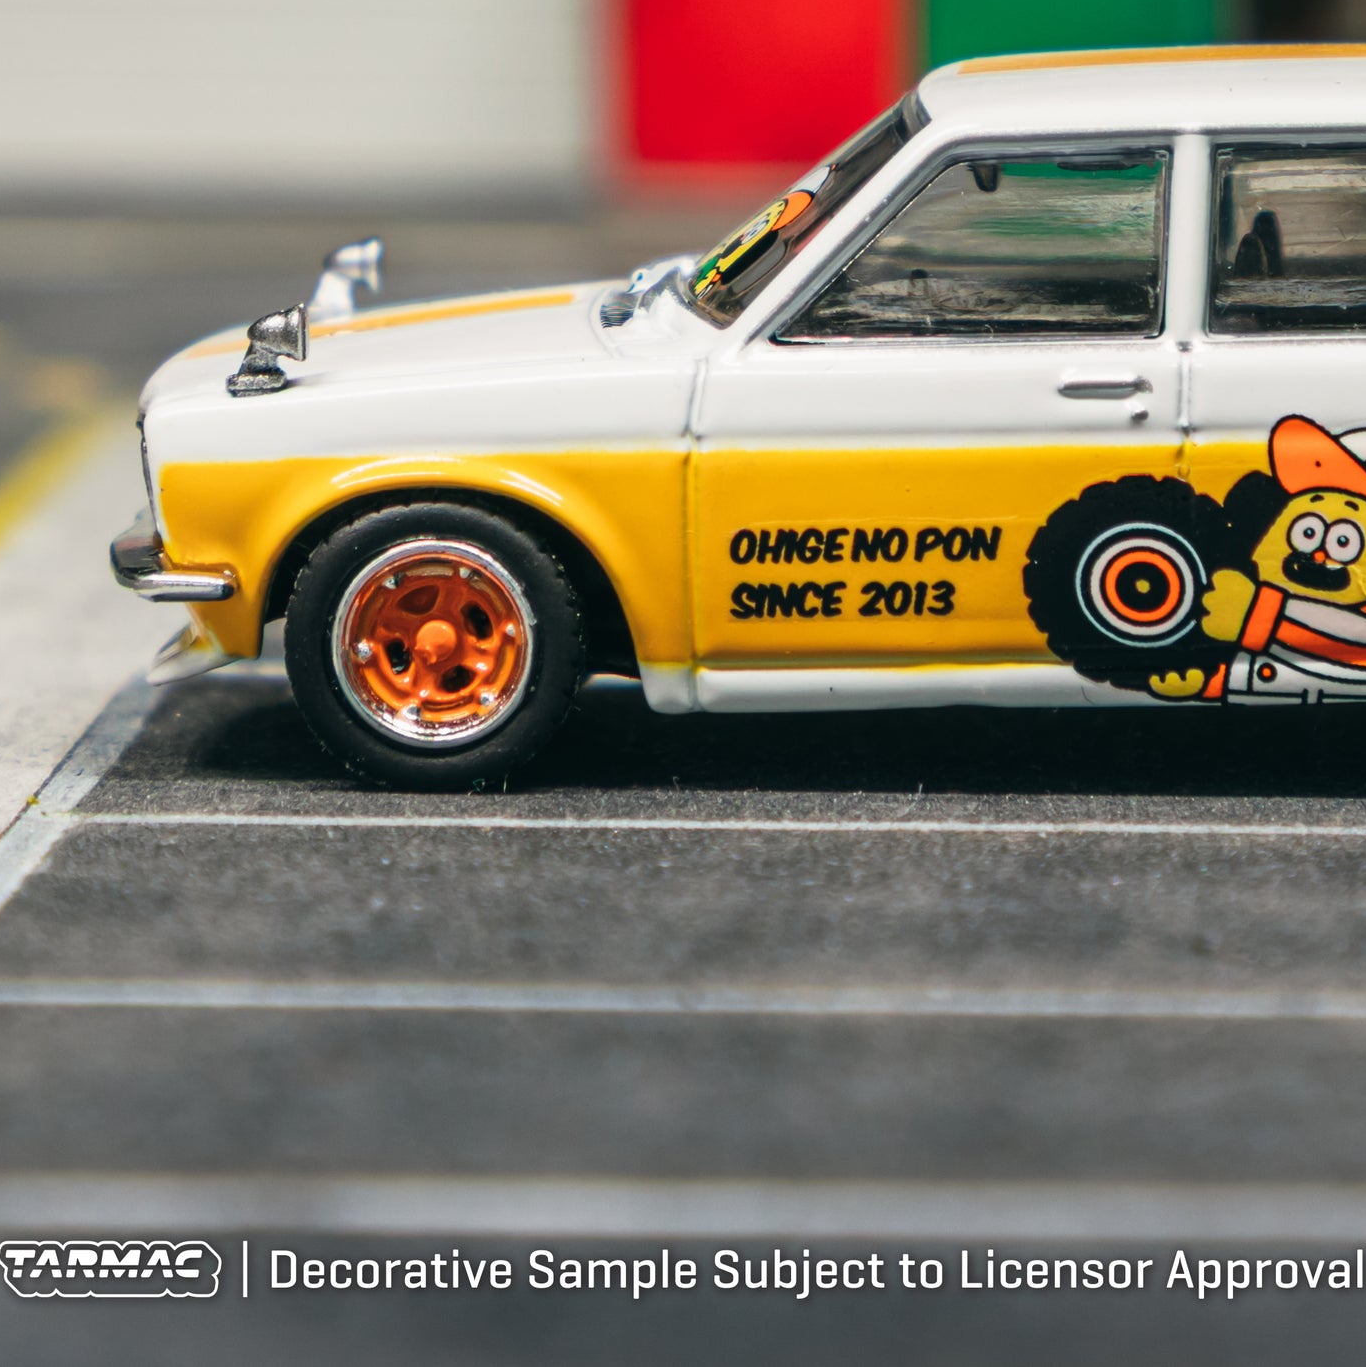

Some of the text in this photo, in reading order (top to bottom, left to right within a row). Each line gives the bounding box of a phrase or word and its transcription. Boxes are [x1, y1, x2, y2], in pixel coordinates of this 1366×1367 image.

[729, 526, 1003, 565] OHIGE NO PON
[729, 580, 957, 619] SINCE 2013
